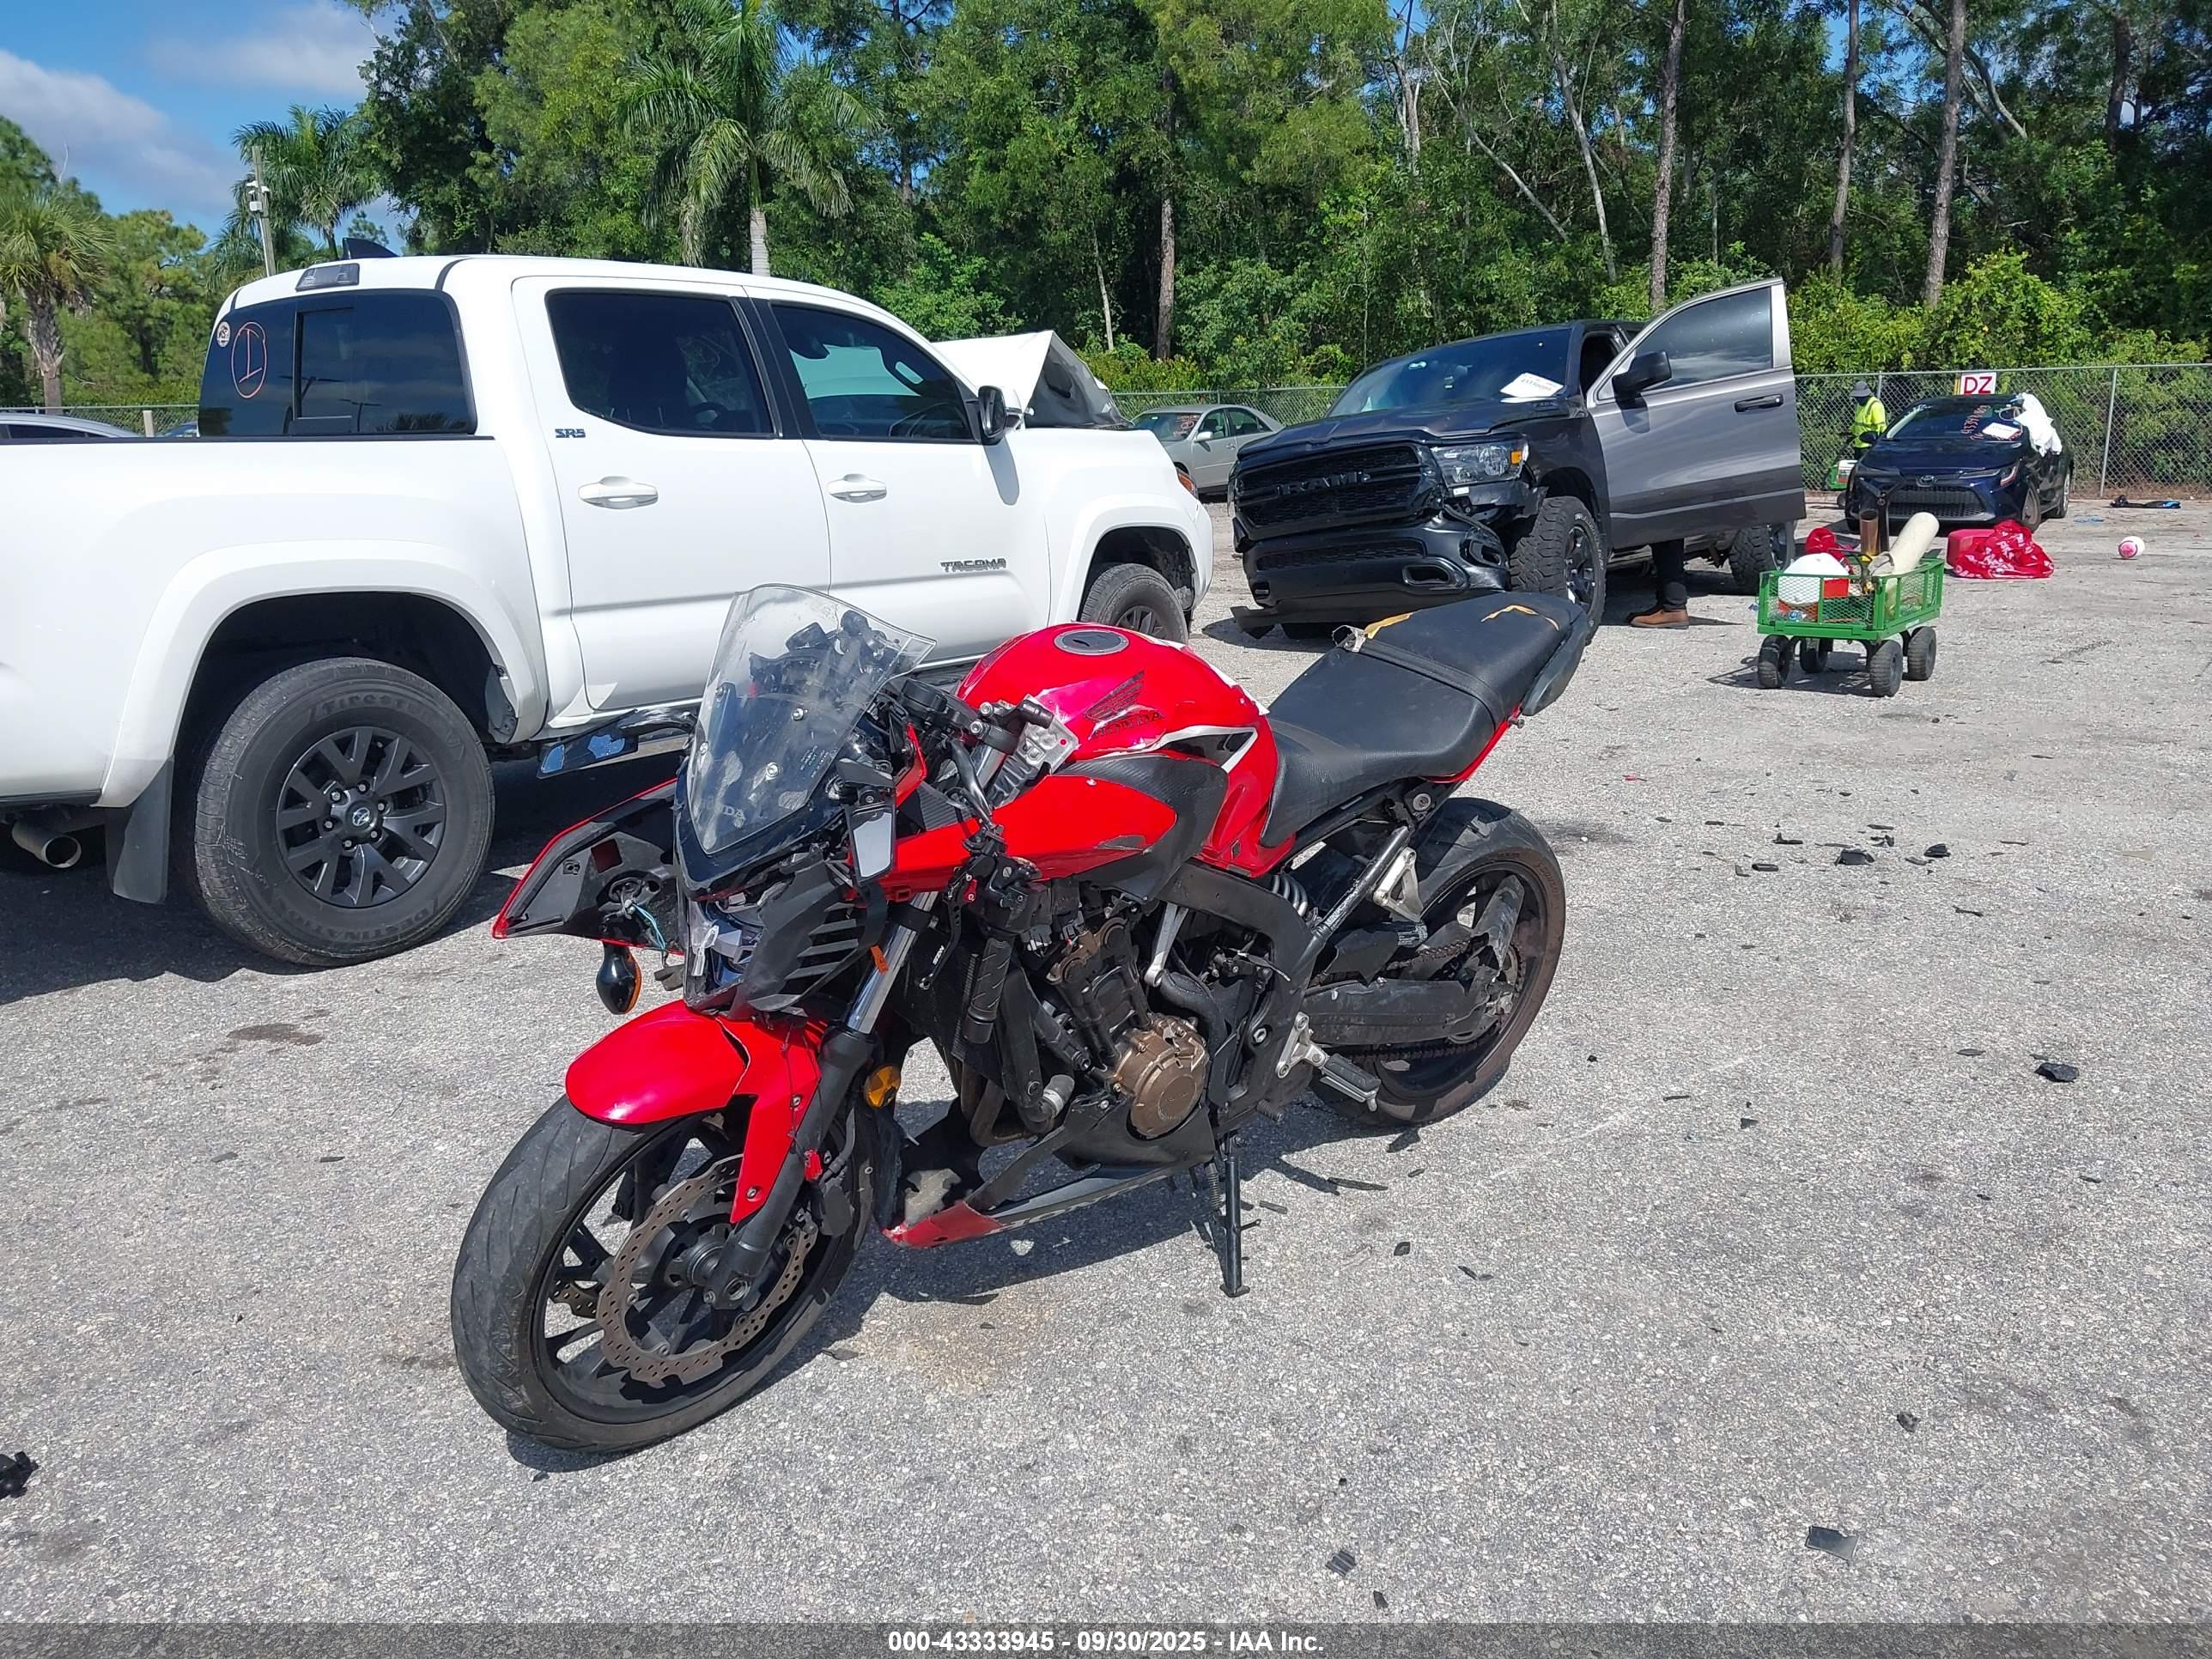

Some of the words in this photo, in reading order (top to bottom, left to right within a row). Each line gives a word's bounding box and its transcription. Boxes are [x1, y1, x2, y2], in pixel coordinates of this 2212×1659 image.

[1963, 376, 1993, 395] DZ
[555, 428, 586, 439] SR5
[940, 557, 1006, 573] TACOMA
